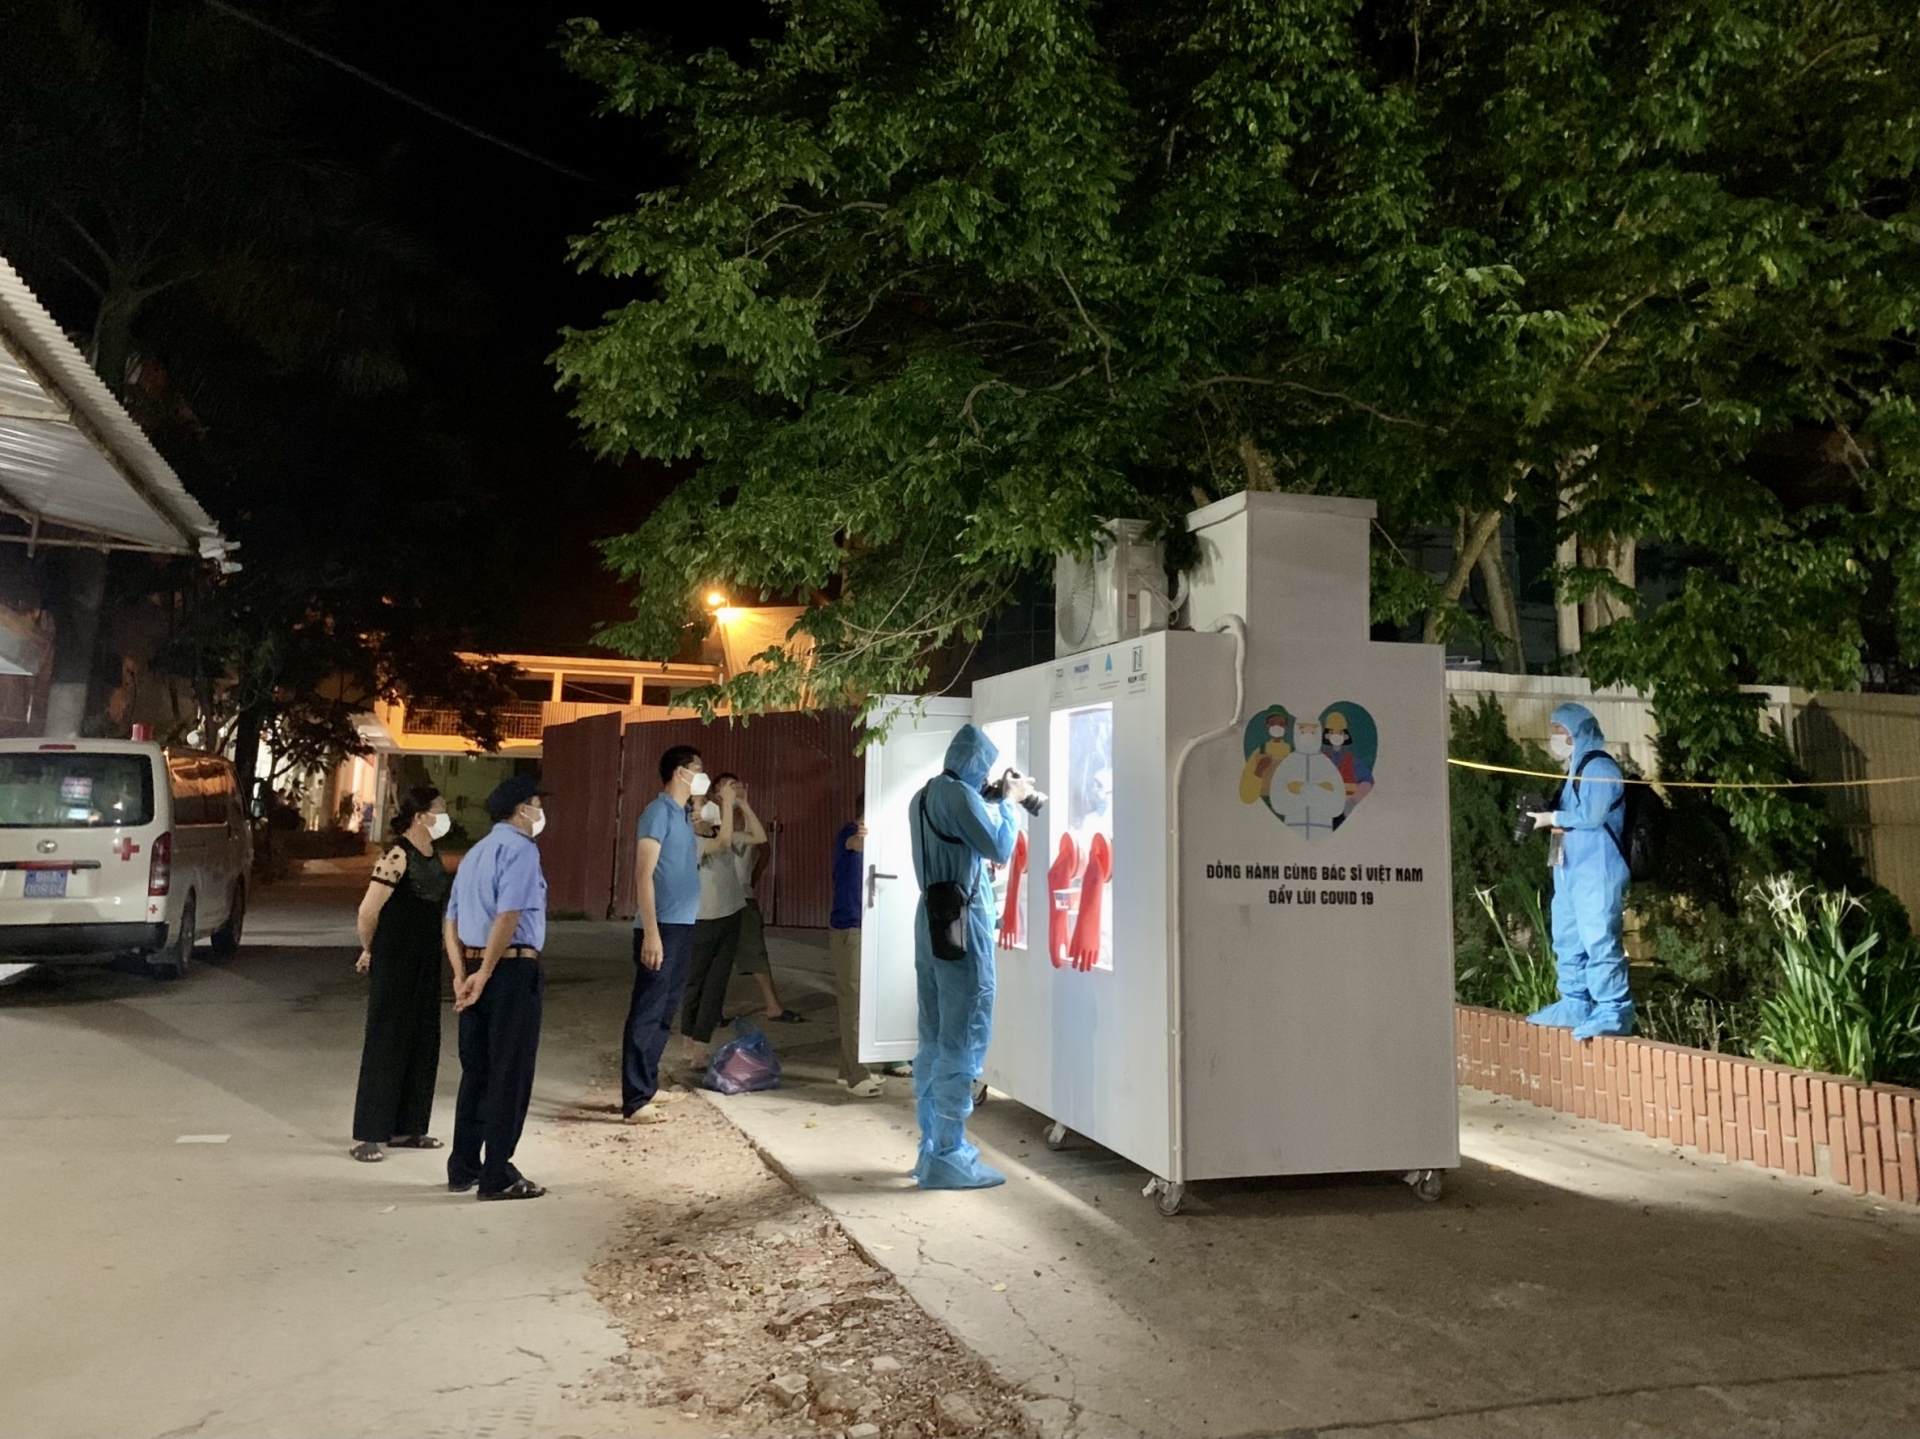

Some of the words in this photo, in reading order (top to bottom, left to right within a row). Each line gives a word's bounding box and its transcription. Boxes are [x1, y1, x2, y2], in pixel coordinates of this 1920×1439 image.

[1206, 860, 1241, 879] ĐỒNG
[1246, 863, 1279, 879] HÀNH
[1284, 863, 1317, 880] CÙNG
[1322, 864, 1346, 881] BÁC
[1350, 864, 1362, 881] SĨ
[1366, 865, 1391, 884] VIỆT
[1396, 868, 1423, 882] NAM
[1268, 884, 1293, 904] ĐẨY
[1320, 891, 1357, 905] COVID
[1361, 892, 1373, 905] 19
